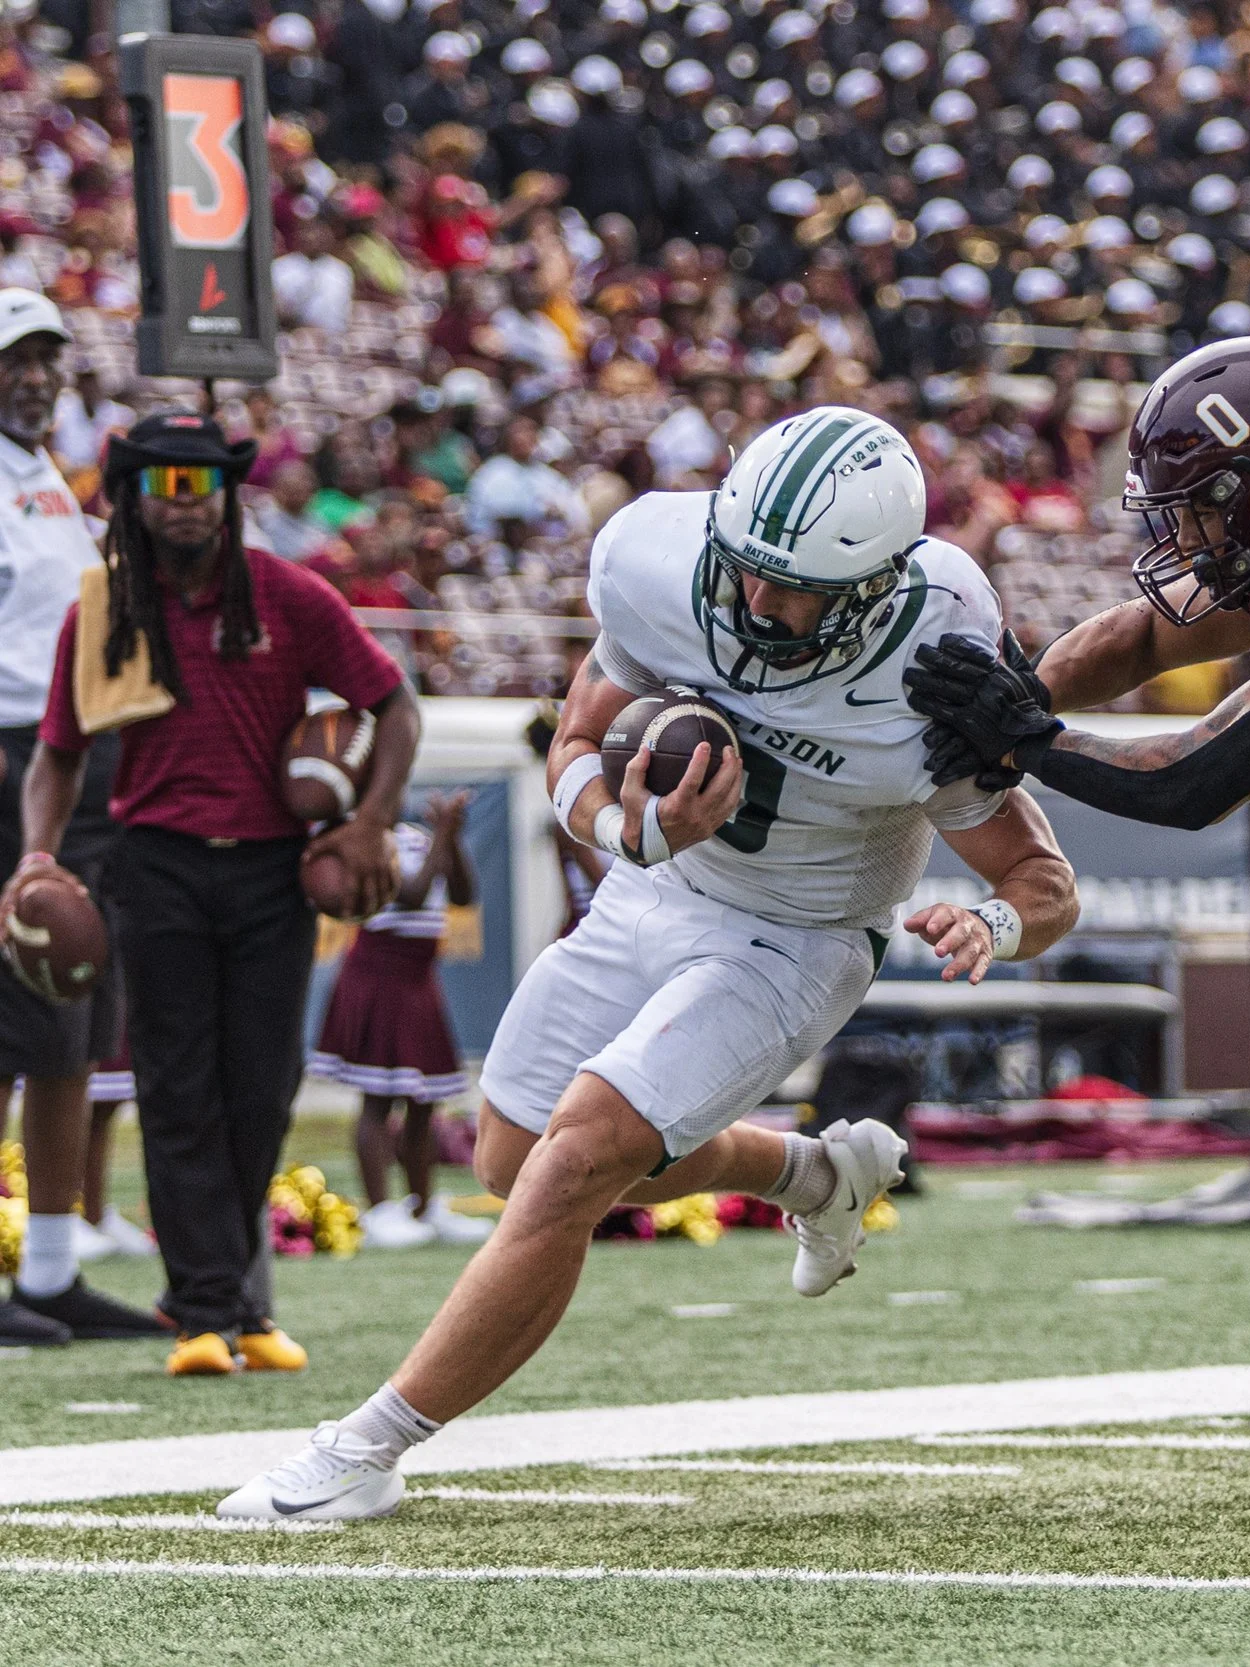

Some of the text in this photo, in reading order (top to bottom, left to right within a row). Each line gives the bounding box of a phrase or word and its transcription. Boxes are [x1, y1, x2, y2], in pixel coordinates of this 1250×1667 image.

[163, 73, 249, 248] 3
[1196, 393, 1250, 447] 0
[743, 543, 790, 569] HATTERS
